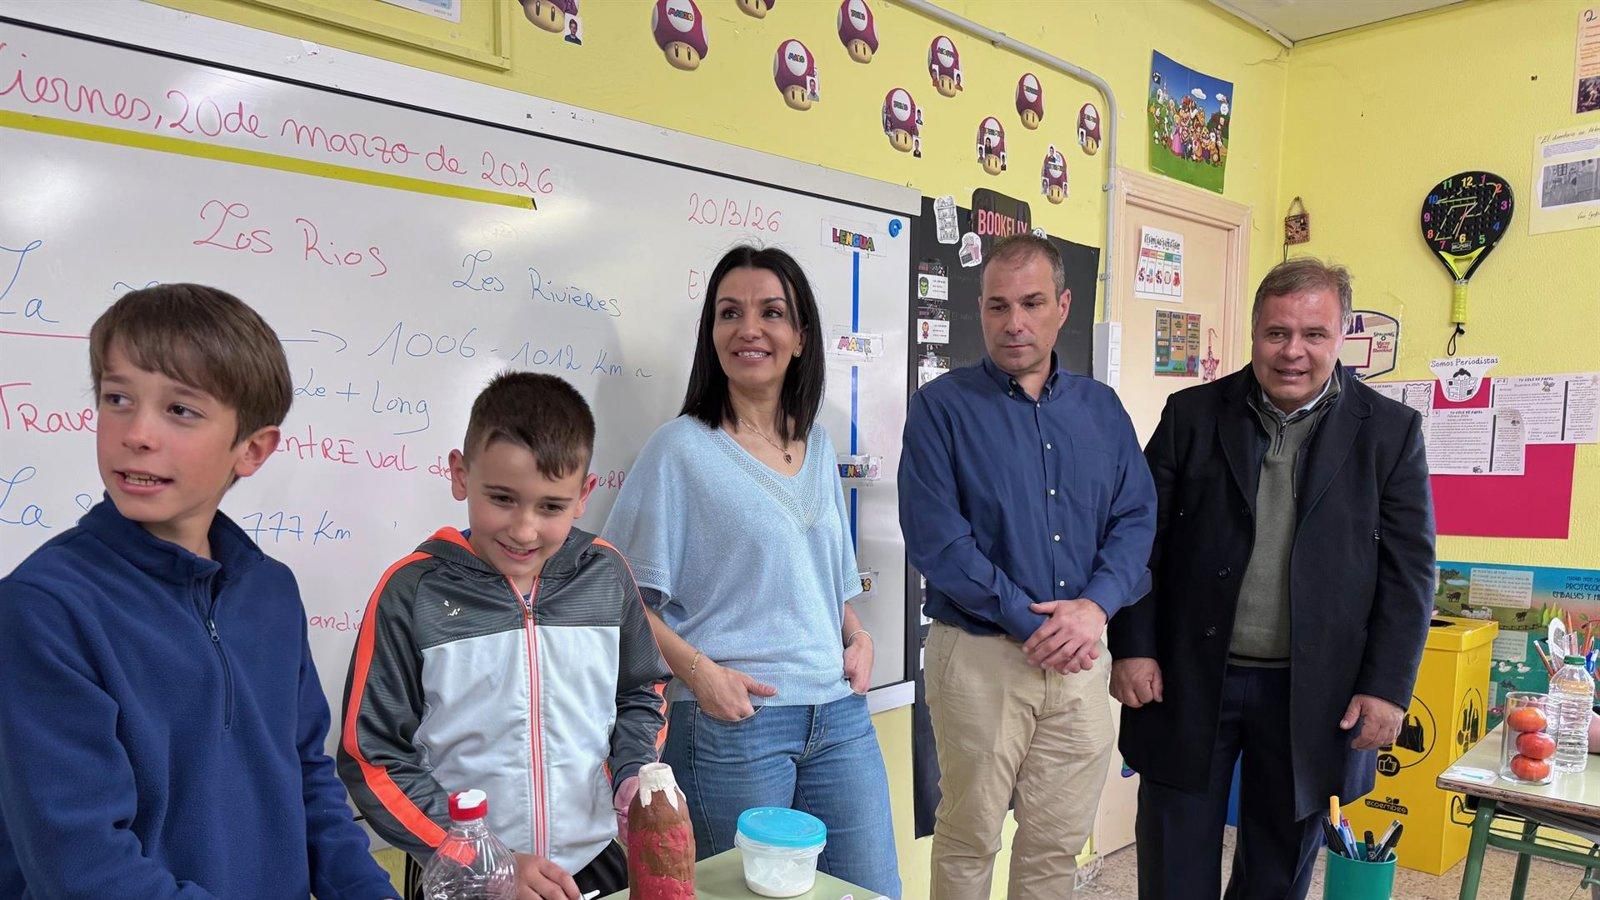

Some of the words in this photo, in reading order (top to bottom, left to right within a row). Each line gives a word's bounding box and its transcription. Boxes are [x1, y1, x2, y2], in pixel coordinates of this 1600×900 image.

[281, 118, 419, 164] marzo
[425, 145, 468, 174] de
[480, 151, 554, 194] 2026
[1443, 179, 1453, 190] 11
[1461, 176, 1473, 187] 12
[1481, 174, 1486, 185] 1
[1496, 183, 1503, 194] 2
[1428, 194, 1439, 205] 10
[1500, 200, 1508, 211] 3
[687, 192, 783, 232] 20/3/26
[1423, 212, 1431, 222] 9
[1493, 221, 1500, 231] 4
[193, 199, 273, 254] Los
[295, 217, 388, 278] Rios
[832, 227, 876, 252] LENGUA
[1427, 229, 1434, 239] 8
[1459, 233, 1467, 243] 6
[1479, 234, 1486, 245] 5
[1440, 240, 1447, 250] 7
[452, 249, 505, 292] Les
[367, 320, 479, 365] 1006
[510, 341, 582, 372] 1012
[1430, 360, 1454, 368] Somos
[1455, 357, 1498, 366] Periodistas
